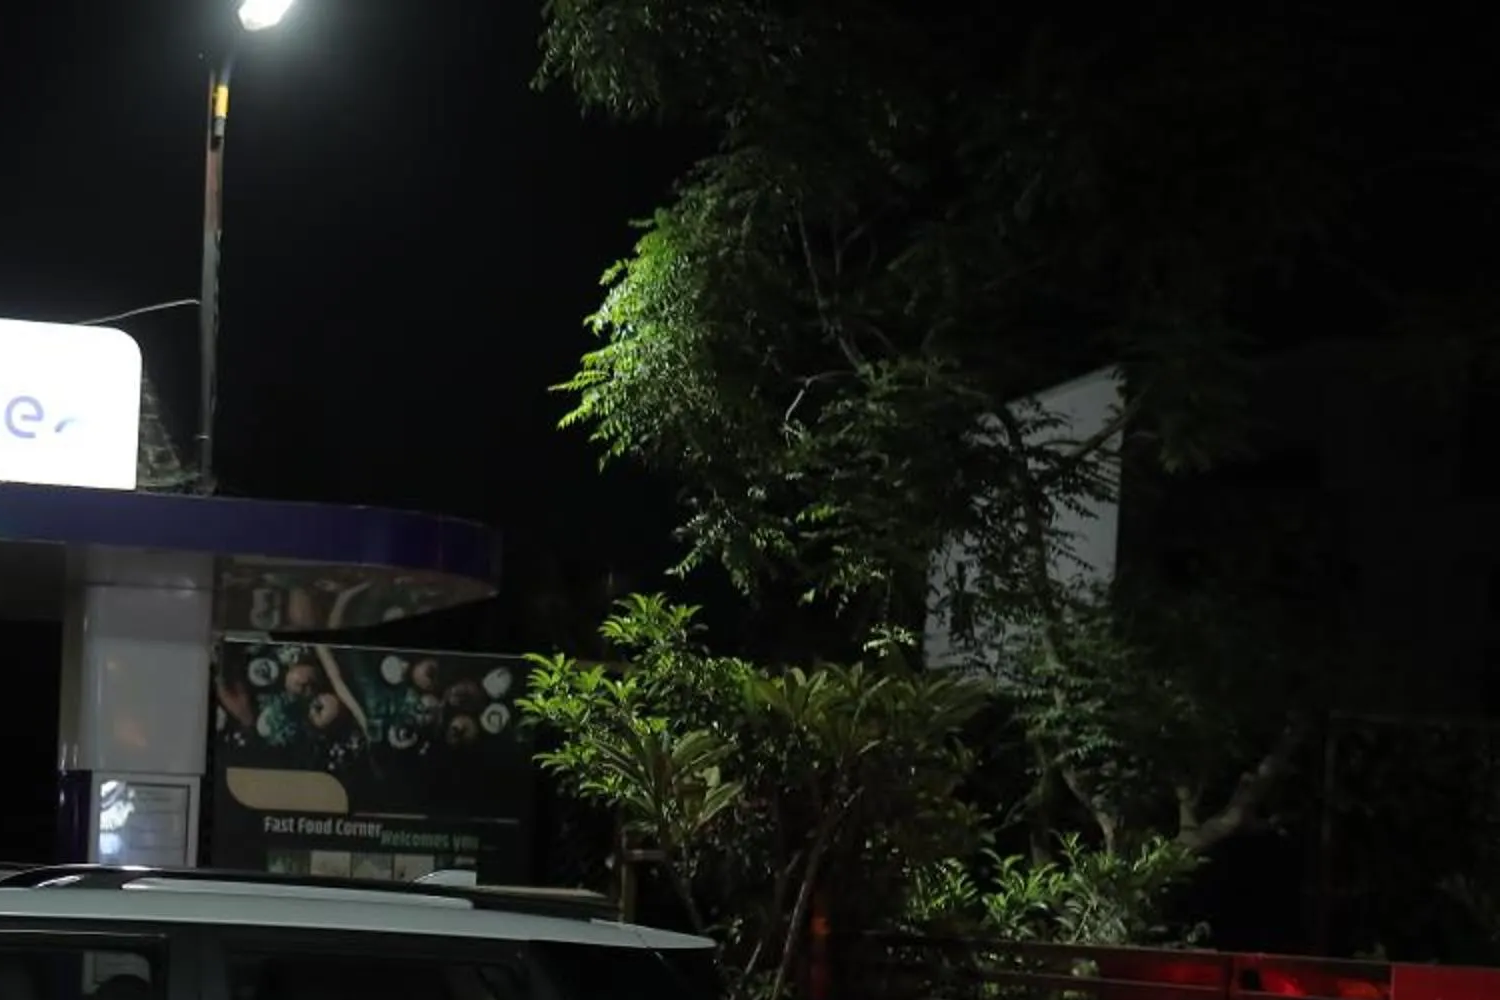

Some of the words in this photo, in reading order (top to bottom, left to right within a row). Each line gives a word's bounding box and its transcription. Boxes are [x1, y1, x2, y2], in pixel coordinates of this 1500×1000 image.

[263, 815, 295, 834] Fast
[297, 817, 333, 836] Food
[335, 818, 384, 838] Corner
